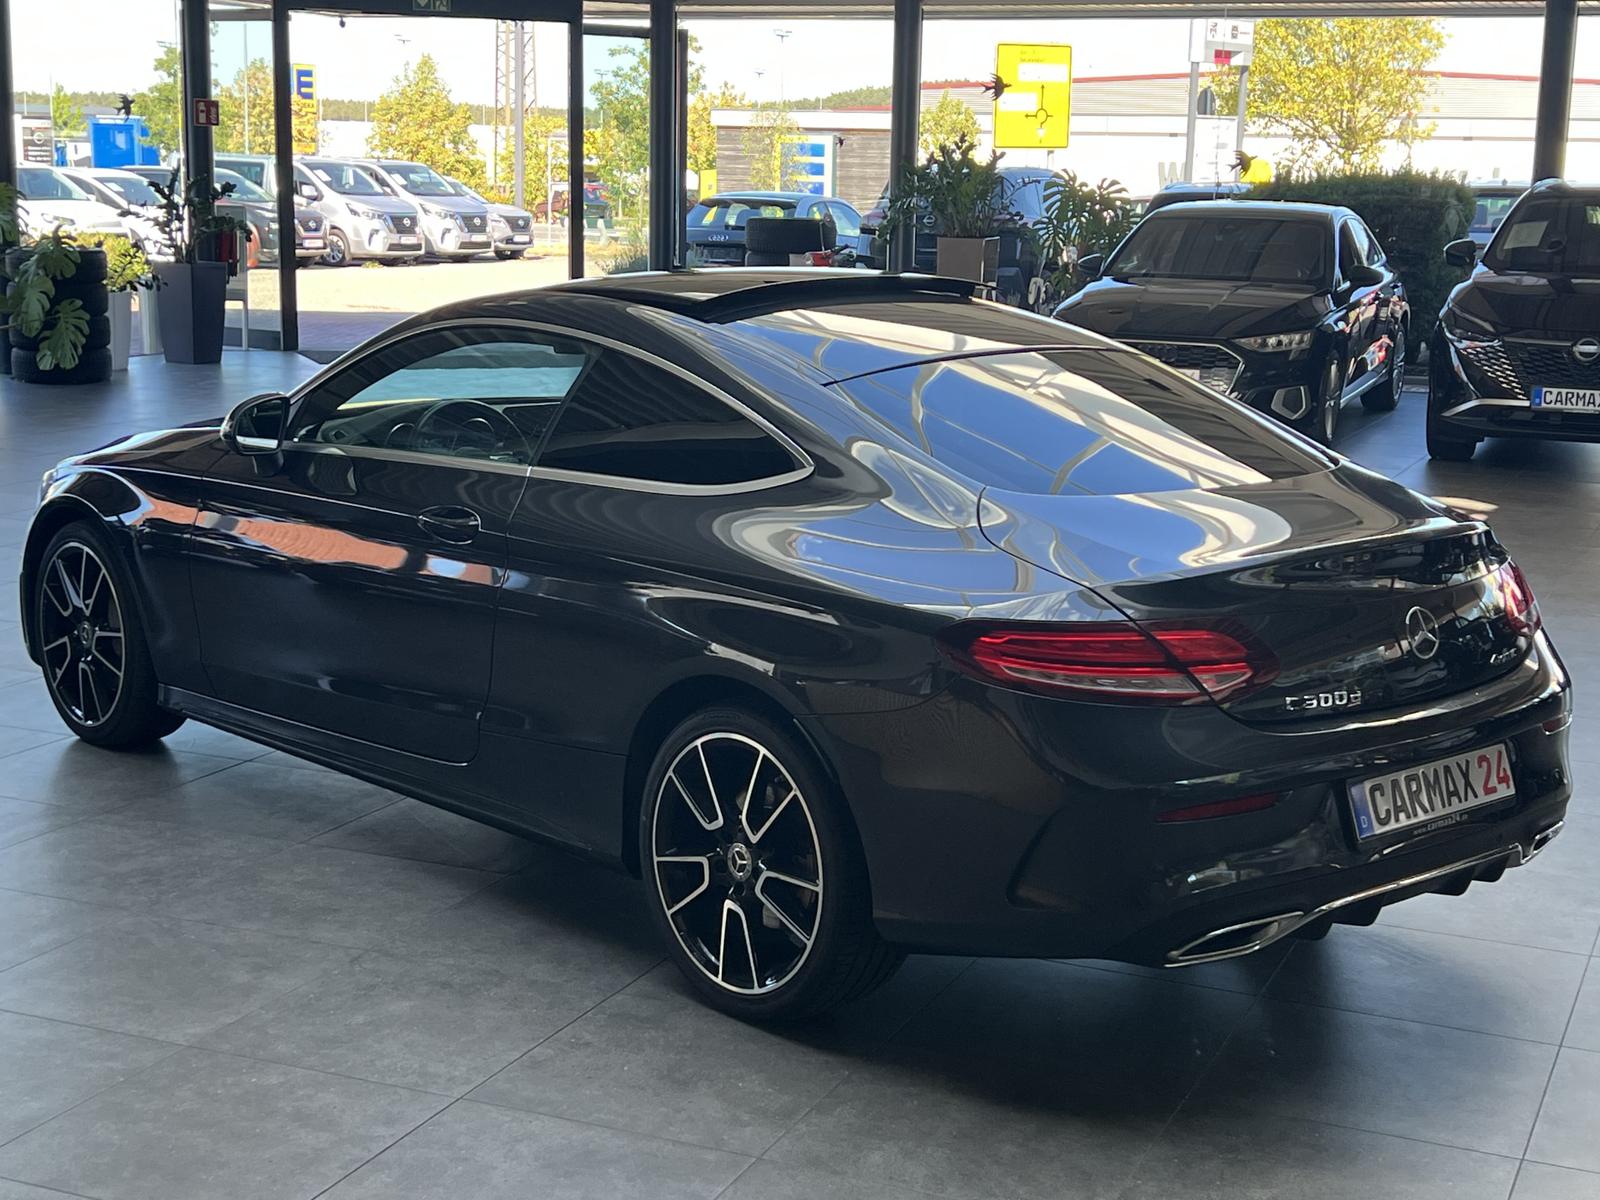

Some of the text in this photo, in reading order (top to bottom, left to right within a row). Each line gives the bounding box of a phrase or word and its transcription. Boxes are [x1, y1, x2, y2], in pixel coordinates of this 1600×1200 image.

[1543, 390, 1600, 408] CARMA
[1369, 751, 1510, 826] CARMAX24
[1361, 816, 1368, 828] D
